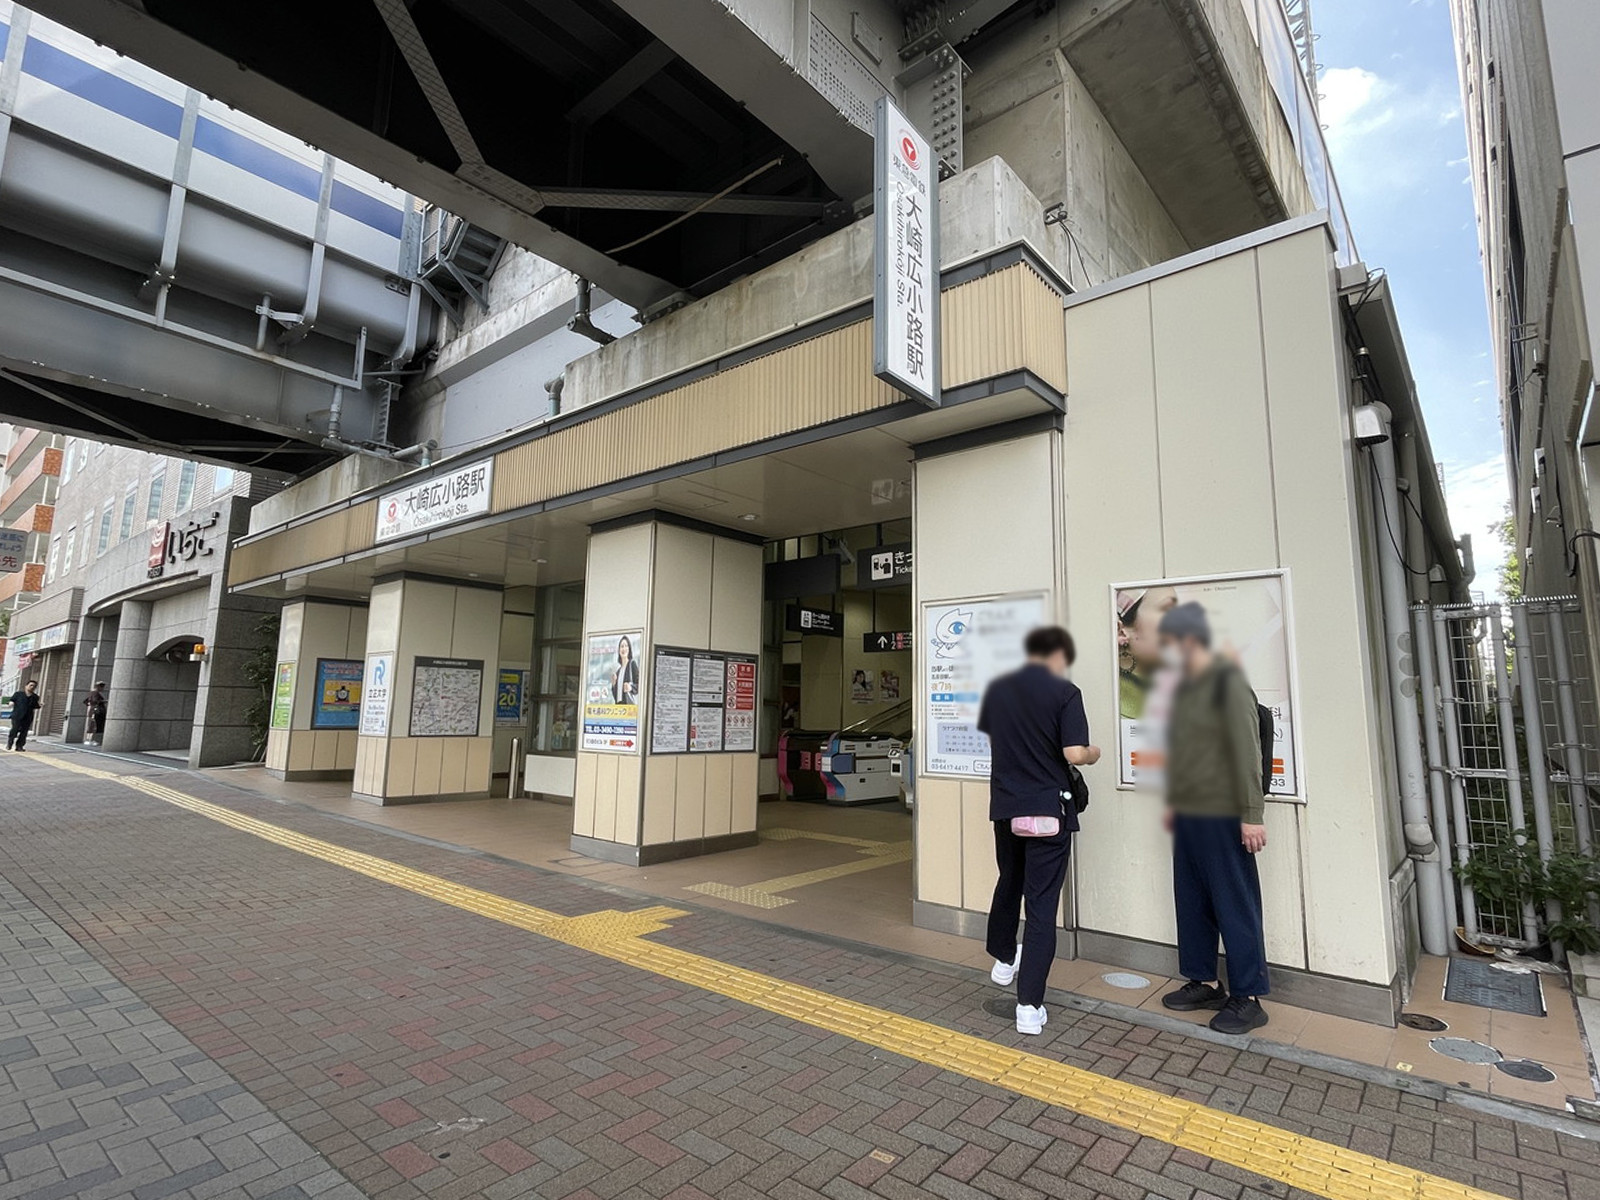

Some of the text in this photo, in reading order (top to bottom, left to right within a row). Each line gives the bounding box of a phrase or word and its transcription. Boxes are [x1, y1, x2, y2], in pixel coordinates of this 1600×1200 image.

[896, 279, 905, 307] Sta.
[905, 194, 924, 381] 大崎広小路駅
[404, 467, 485, 516] 大崎広小路駅
